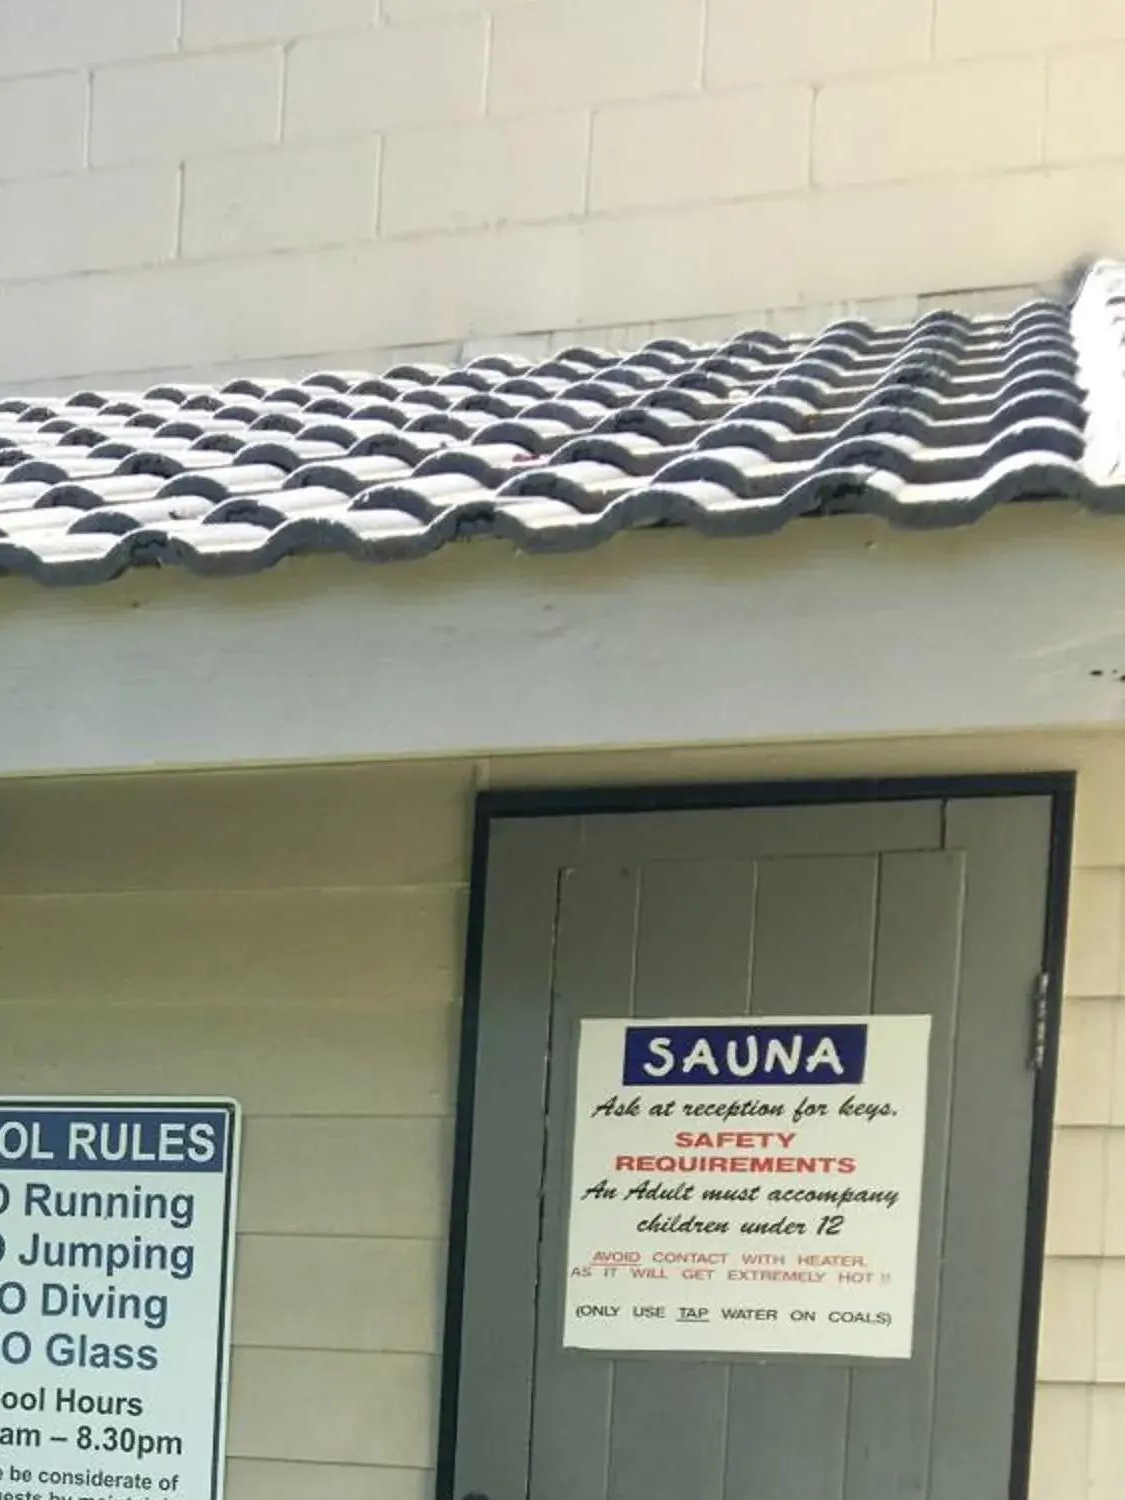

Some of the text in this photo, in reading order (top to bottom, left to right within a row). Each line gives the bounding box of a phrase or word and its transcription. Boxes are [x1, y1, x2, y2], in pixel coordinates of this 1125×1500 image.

[643, 1035, 845, 1077] SAUNA
[590, 1096, 898, 1122] Ask at reception for keys.
[69, 1122, 216, 1163] RULES
[674, 1131, 796, 1148] SAFETY
[615, 1155, 857, 1173] REQUIREMENTS
[25, 1183, 195, 1228] Running
[581, 1179, 900, 1208] An Adult must accompany
[636, 1213, 845, 1236] children under 12
[19, 1233, 195, 1279] Jumping
[592, 1251, 641, 1265] AVOID
[653, 1252, 728, 1266] CONTACT
[742, 1254, 785, 1266] WITH
[571, 1267, 592, 1279] AS
[603, 1268, 618, 1279] IT
[631, 1268, 666, 1279] WILL
[683, 1269, 714, 1281] GET
[727, 1269, 825, 1283] EXTREMELY
[838, 1271, 876, 1285] HOT
[42, 1283, 167, 1328] Diving
[576, 1305, 893, 1326] (ONLY USE TAP WATER ON COALS)
[46, 1333, 158, 1371] Glass
[56, 1388, 143, 1417] Hours
[76, 1425, 183, 1460] 8.30pm
[9, 1464, 32, 1483] be
[38, 1467, 152, 1490] considerate
[158, 1473, 179, 1491] of
